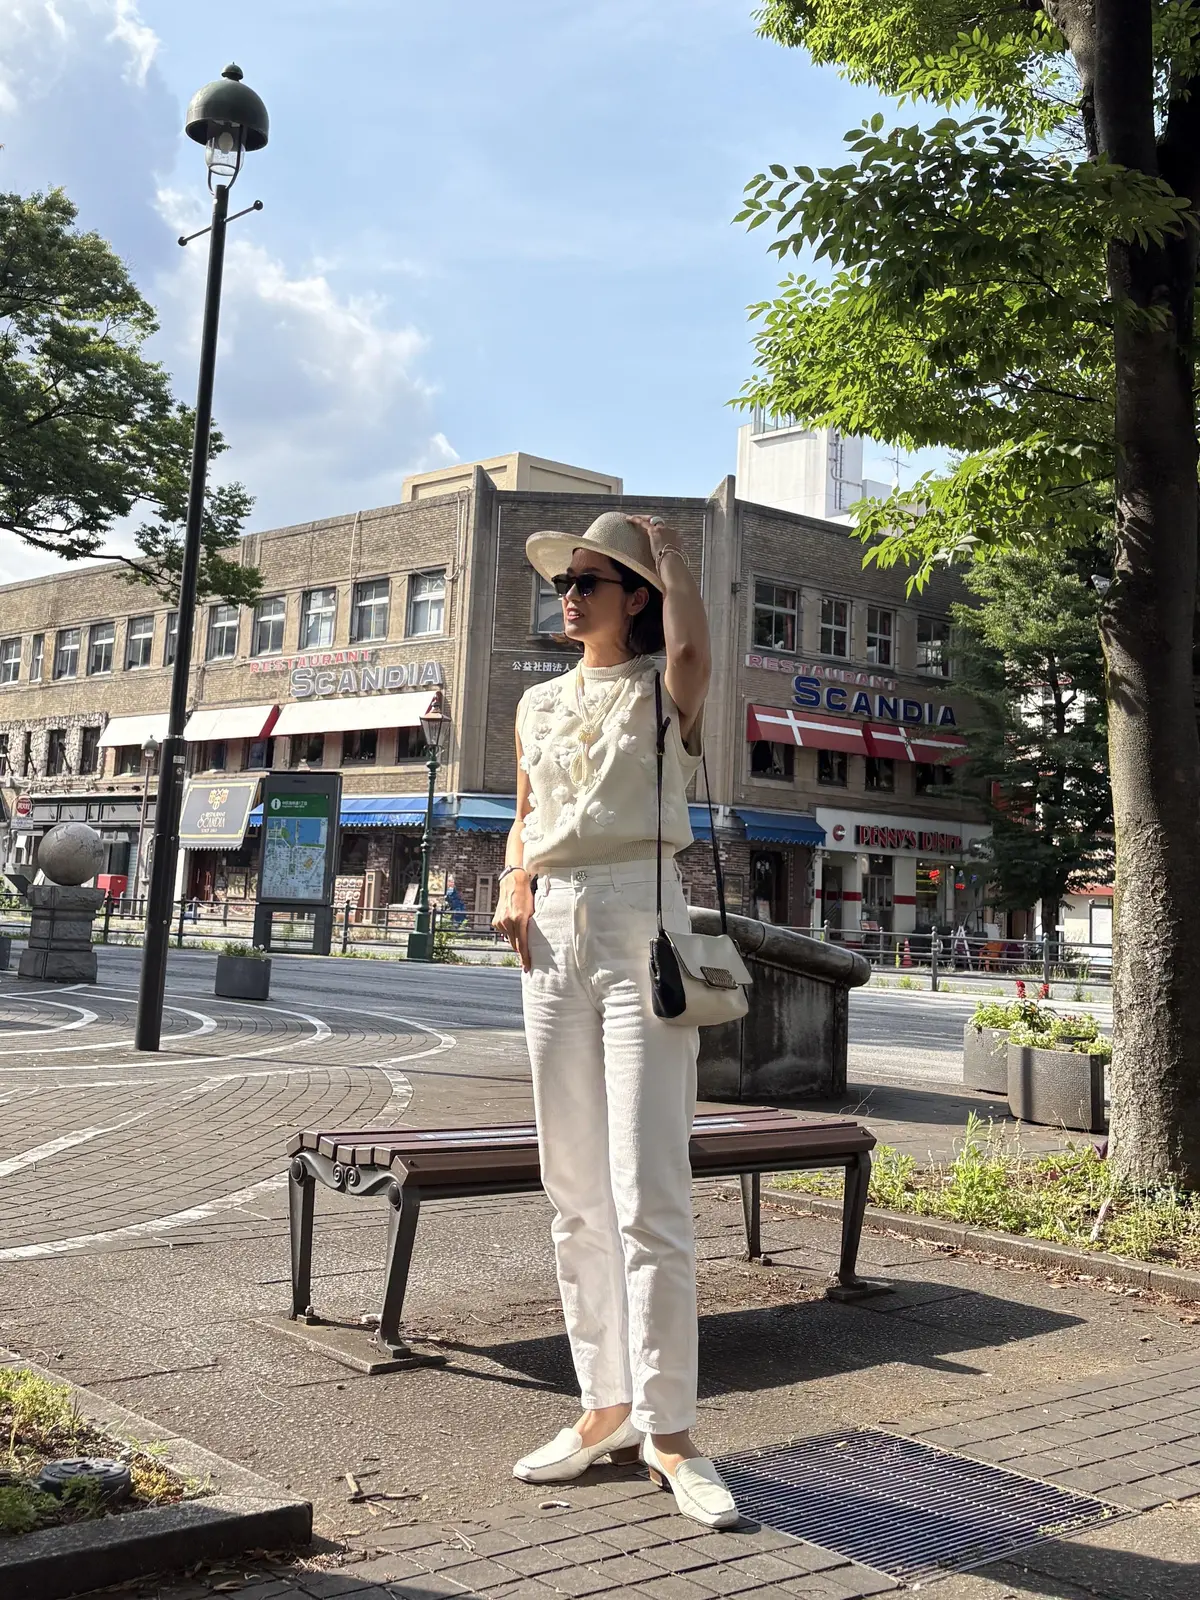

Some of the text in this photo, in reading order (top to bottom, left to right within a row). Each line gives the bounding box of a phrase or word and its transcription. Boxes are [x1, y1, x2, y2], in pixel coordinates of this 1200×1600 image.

[250, 650, 371, 673] RESTAURANT
[512, 661, 571, 673] 公益社団法人
[745, 654, 899, 691] RESTAURANT
[290, 661, 442, 698] SCANDIA
[792, 675, 957, 726] SCANDIA
[856, 825, 917, 849] PENNY'S
